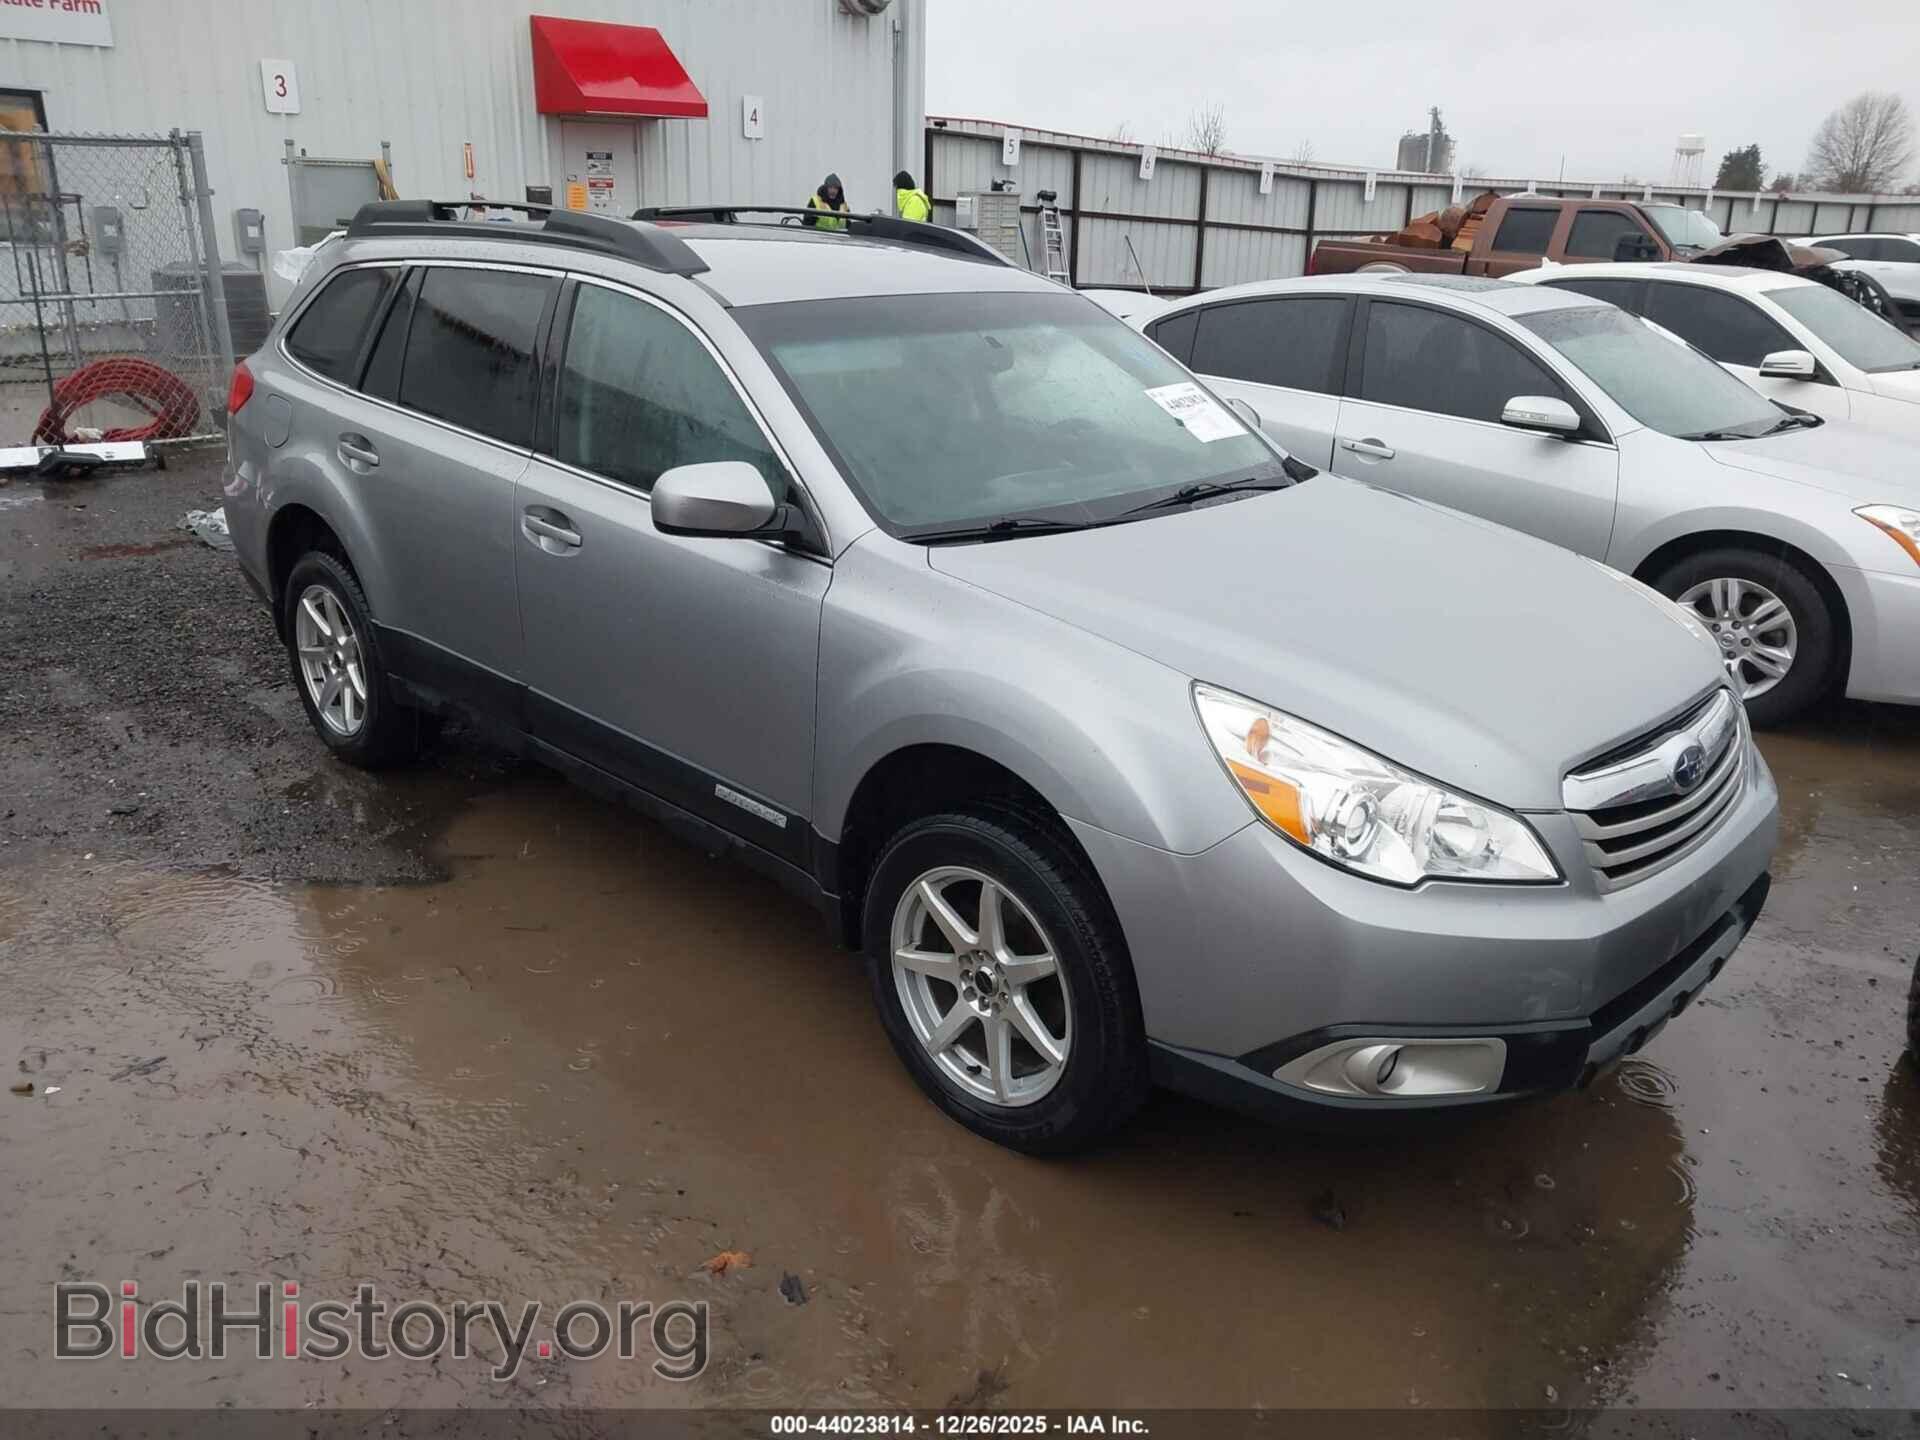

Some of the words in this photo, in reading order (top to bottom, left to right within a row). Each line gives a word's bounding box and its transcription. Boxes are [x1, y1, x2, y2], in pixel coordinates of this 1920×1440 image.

[274, 74, 287, 98] 3
[750, 107, 758, 127] 4
[1007, 138, 1015, 155] 5
[1144, 155, 1151, 170] 6
